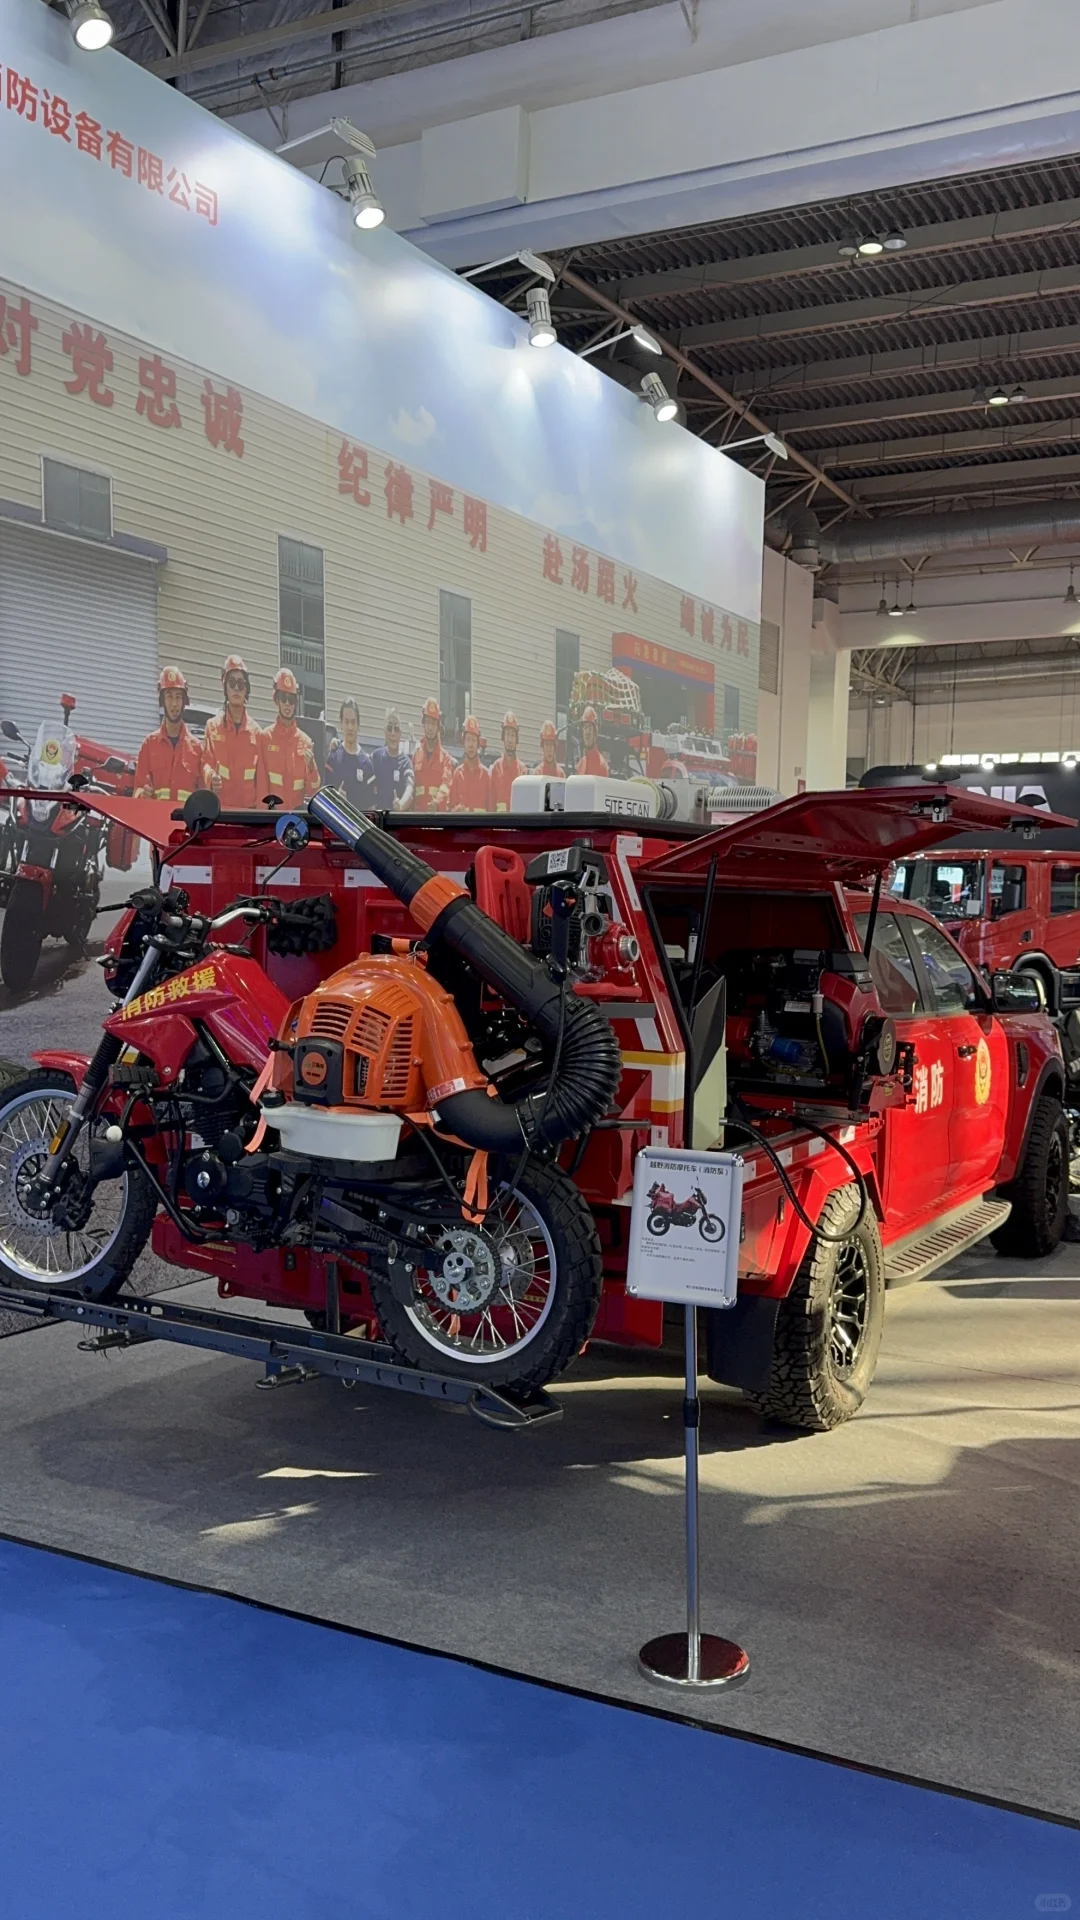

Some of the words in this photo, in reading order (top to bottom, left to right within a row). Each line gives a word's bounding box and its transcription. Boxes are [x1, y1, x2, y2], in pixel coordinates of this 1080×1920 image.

[0, 64, 218, 226] 防设备有限公司
[0, 294, 245, 459] 对党忠诚
[337, 438, 487, 552] 纪律严明
[542, 533, 639, 615] 赴汤蹈火
[122, 966, 217, 1020] 消防救援
[915, 1059, 944, 1113] 消防
